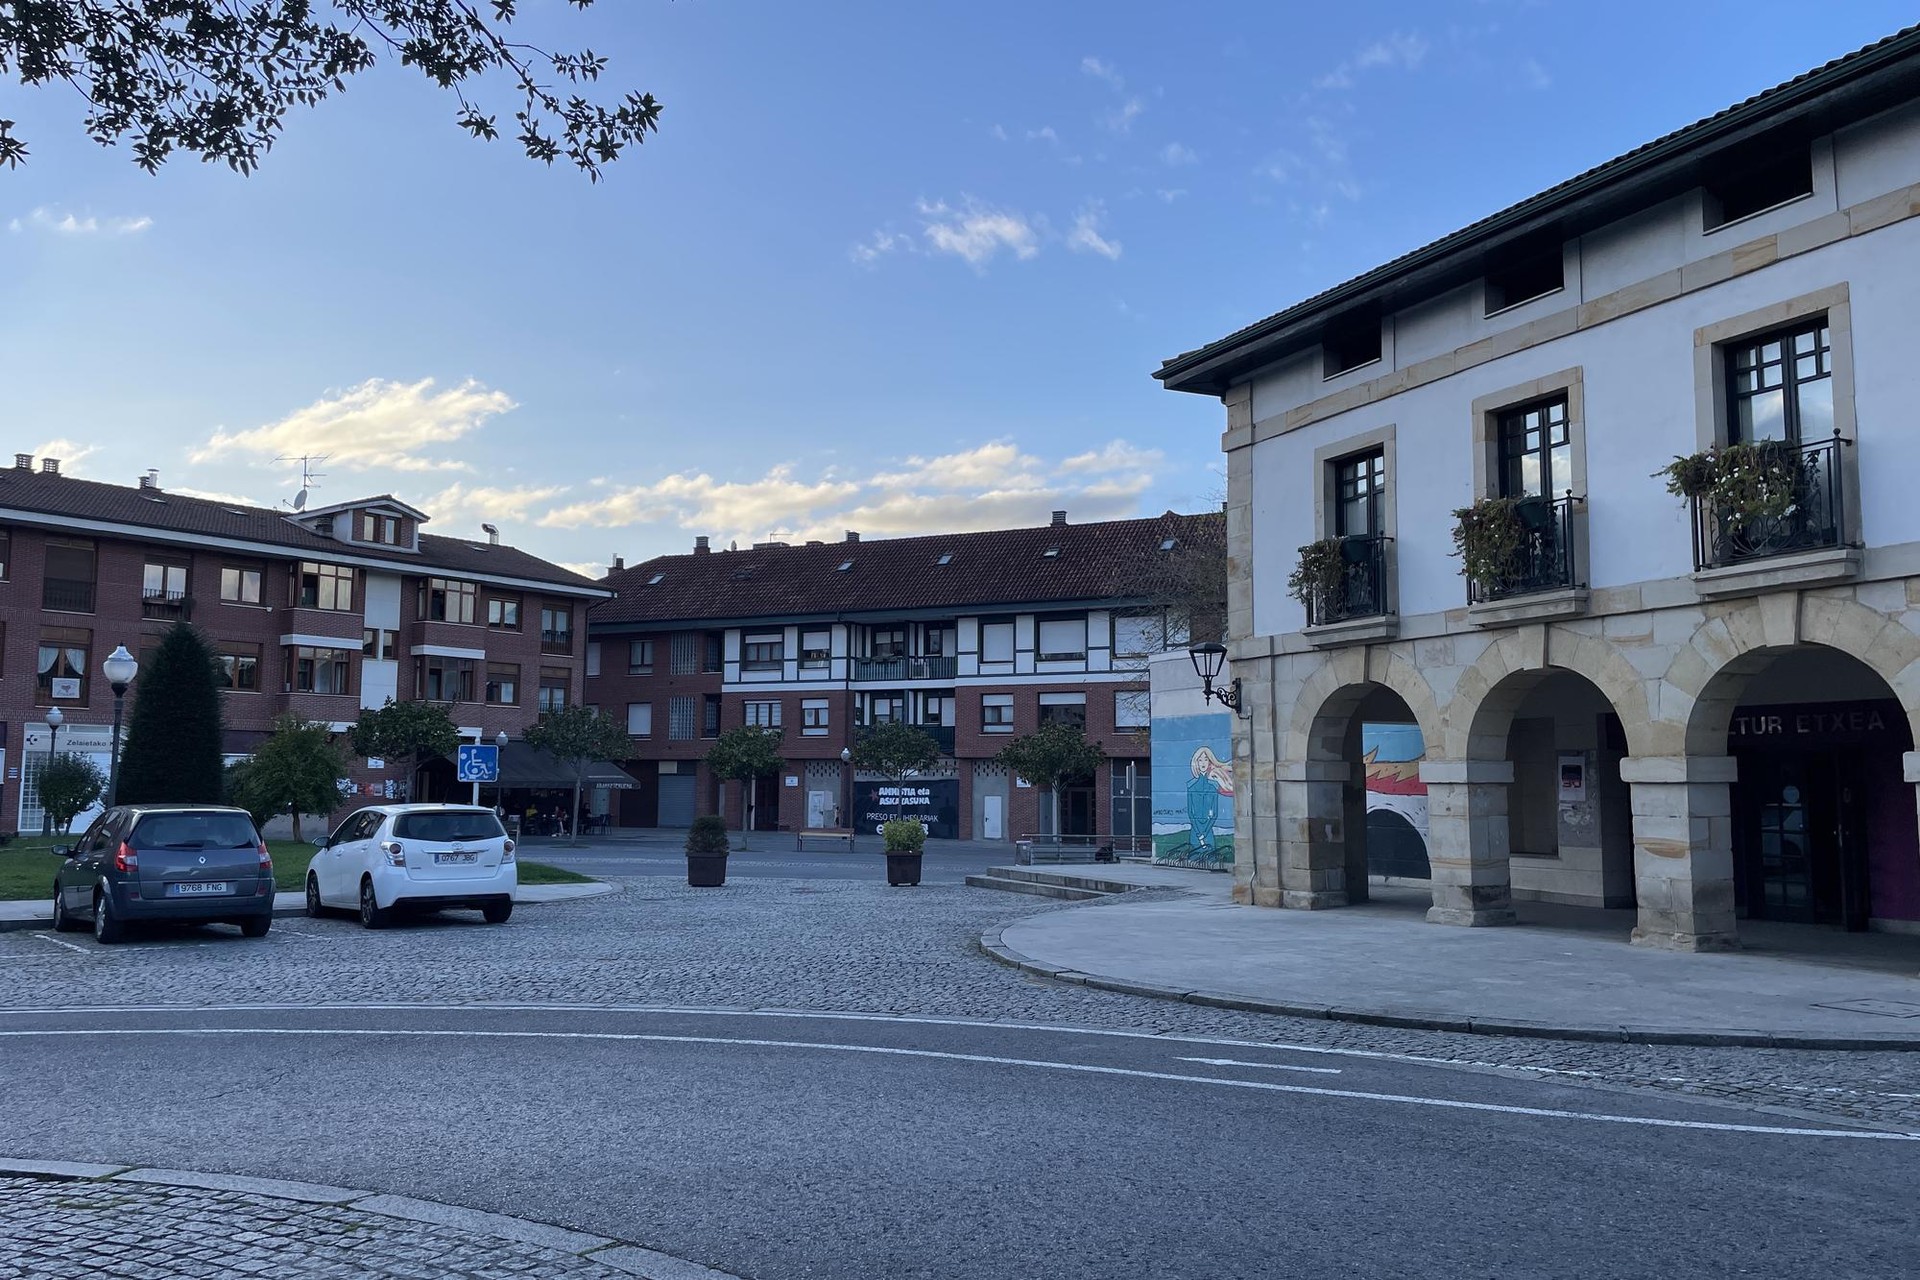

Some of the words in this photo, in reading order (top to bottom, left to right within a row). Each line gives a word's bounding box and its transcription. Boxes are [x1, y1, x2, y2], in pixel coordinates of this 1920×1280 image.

[1796, 710, 1885, 733] ETXEA
[67, 739, 107, 747] Zelaietako
[917, 787, 930, 796] eta
[866, 812, 888, 821] PRESO
[889, 813, 898, 821] ET
[441, 854, 459, 862] 0767
[181, 884, 202, 892] 9768
[206, 883, 222, 891] FNG
